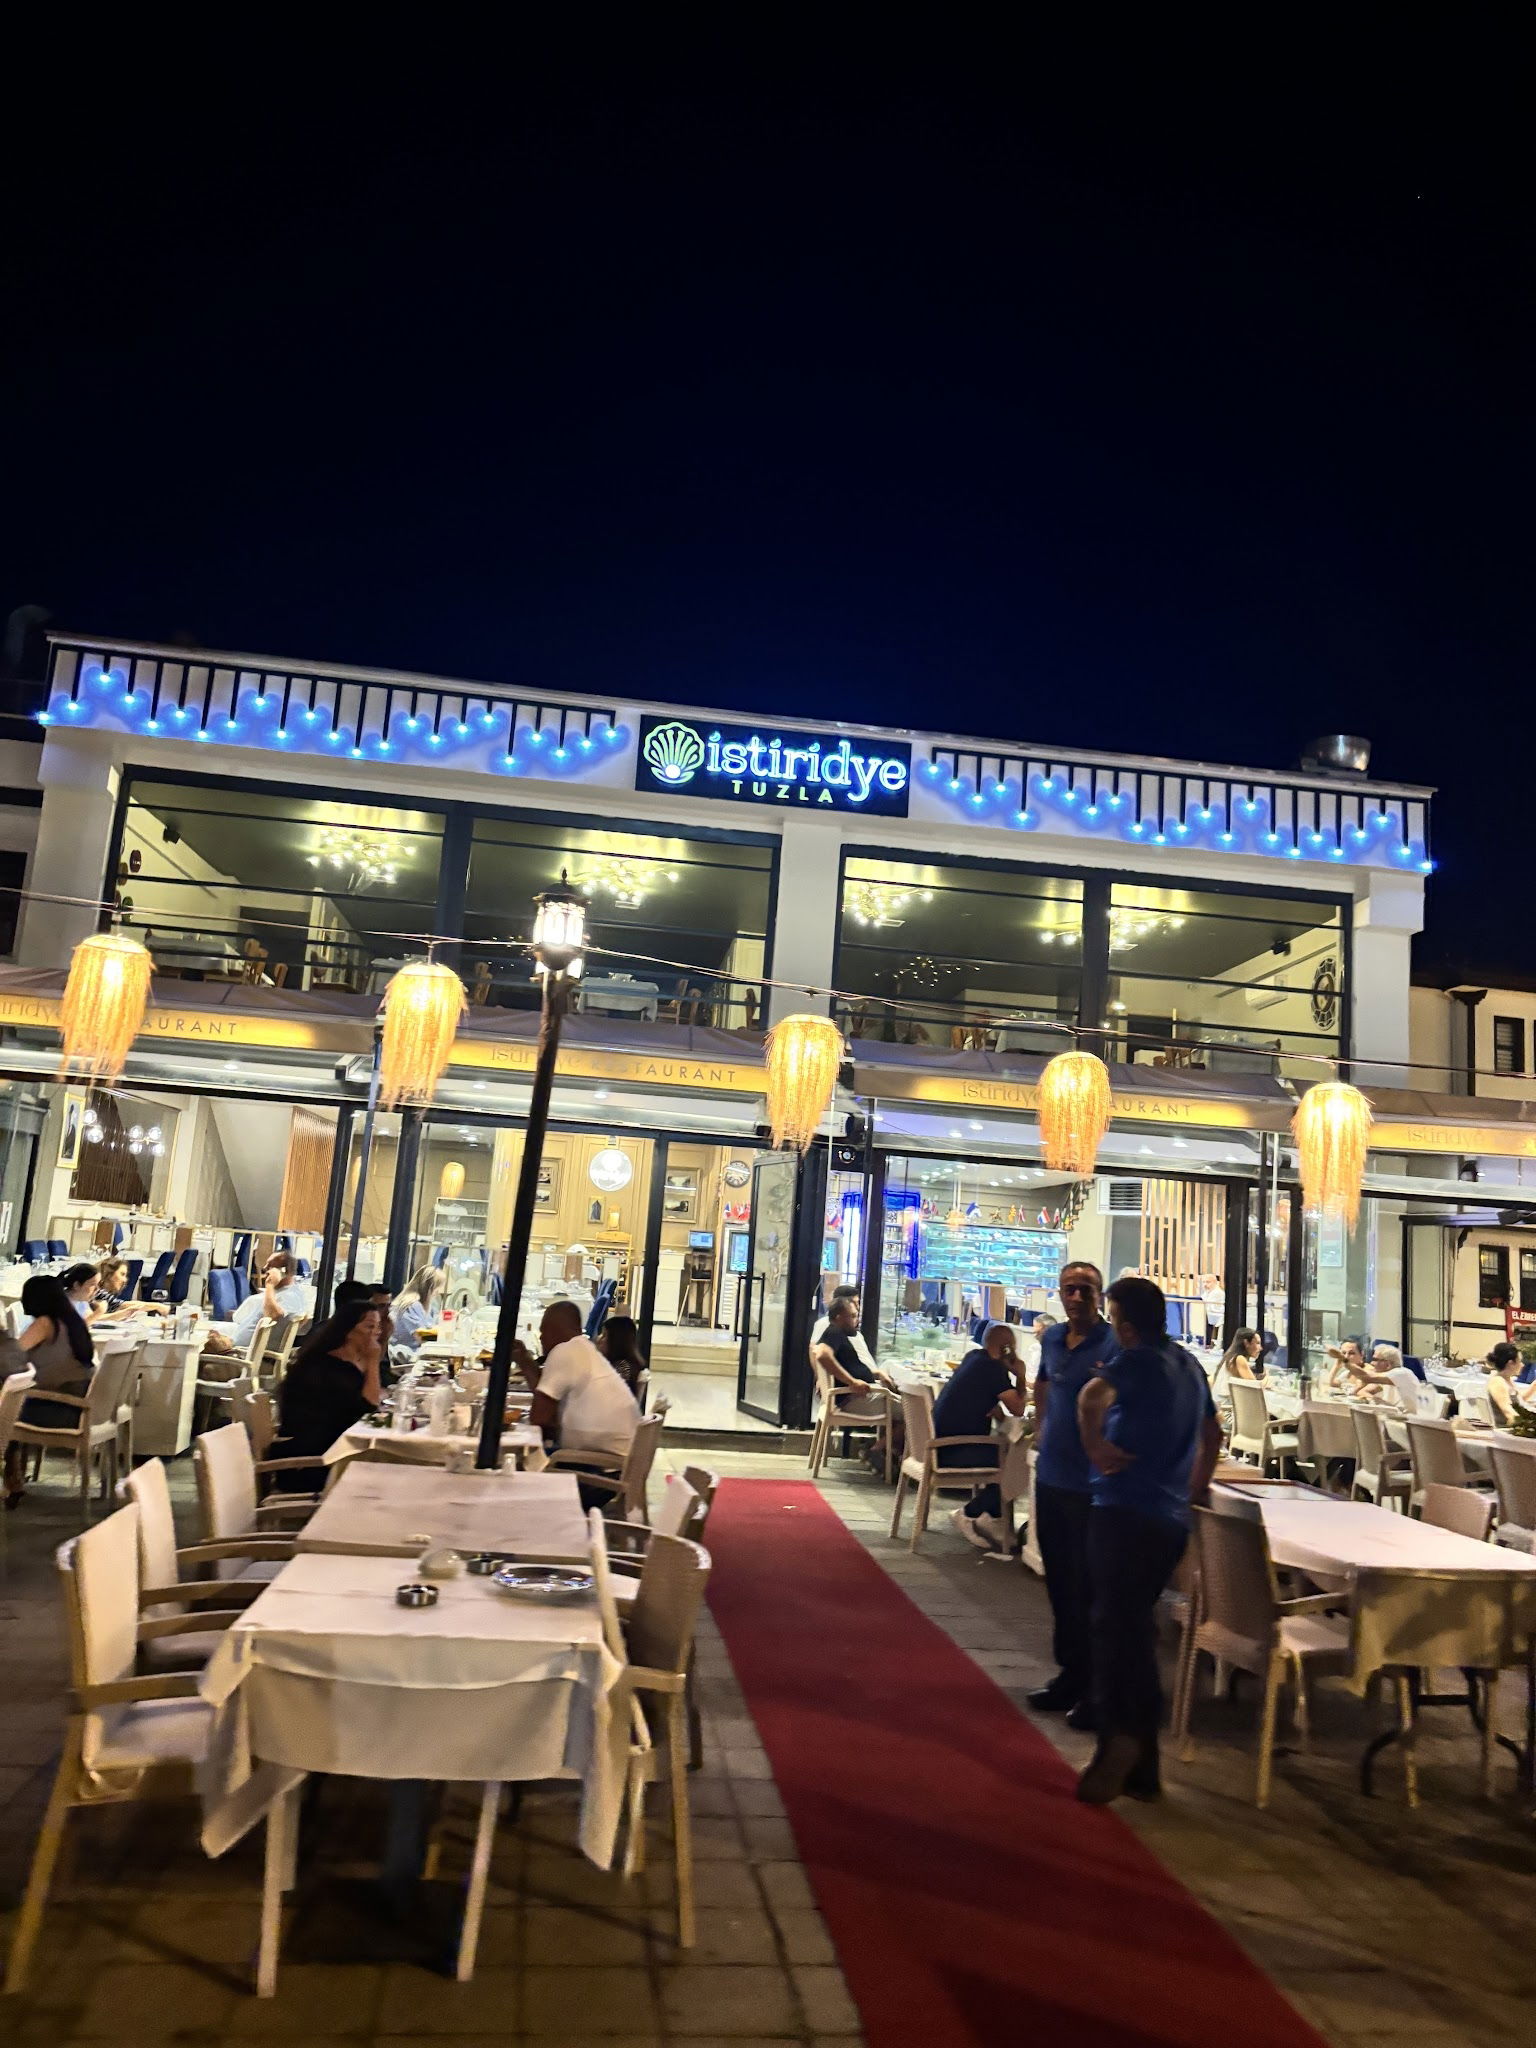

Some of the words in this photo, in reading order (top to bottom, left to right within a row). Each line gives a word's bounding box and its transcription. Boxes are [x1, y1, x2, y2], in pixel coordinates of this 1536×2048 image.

[706, 731, 907, 802] istiridye
[732, 779, 833, 803] TUZLA
[140, 1016, 236, 1035] AURANT
[1108, 1100, 1191, 1117] AURANT
